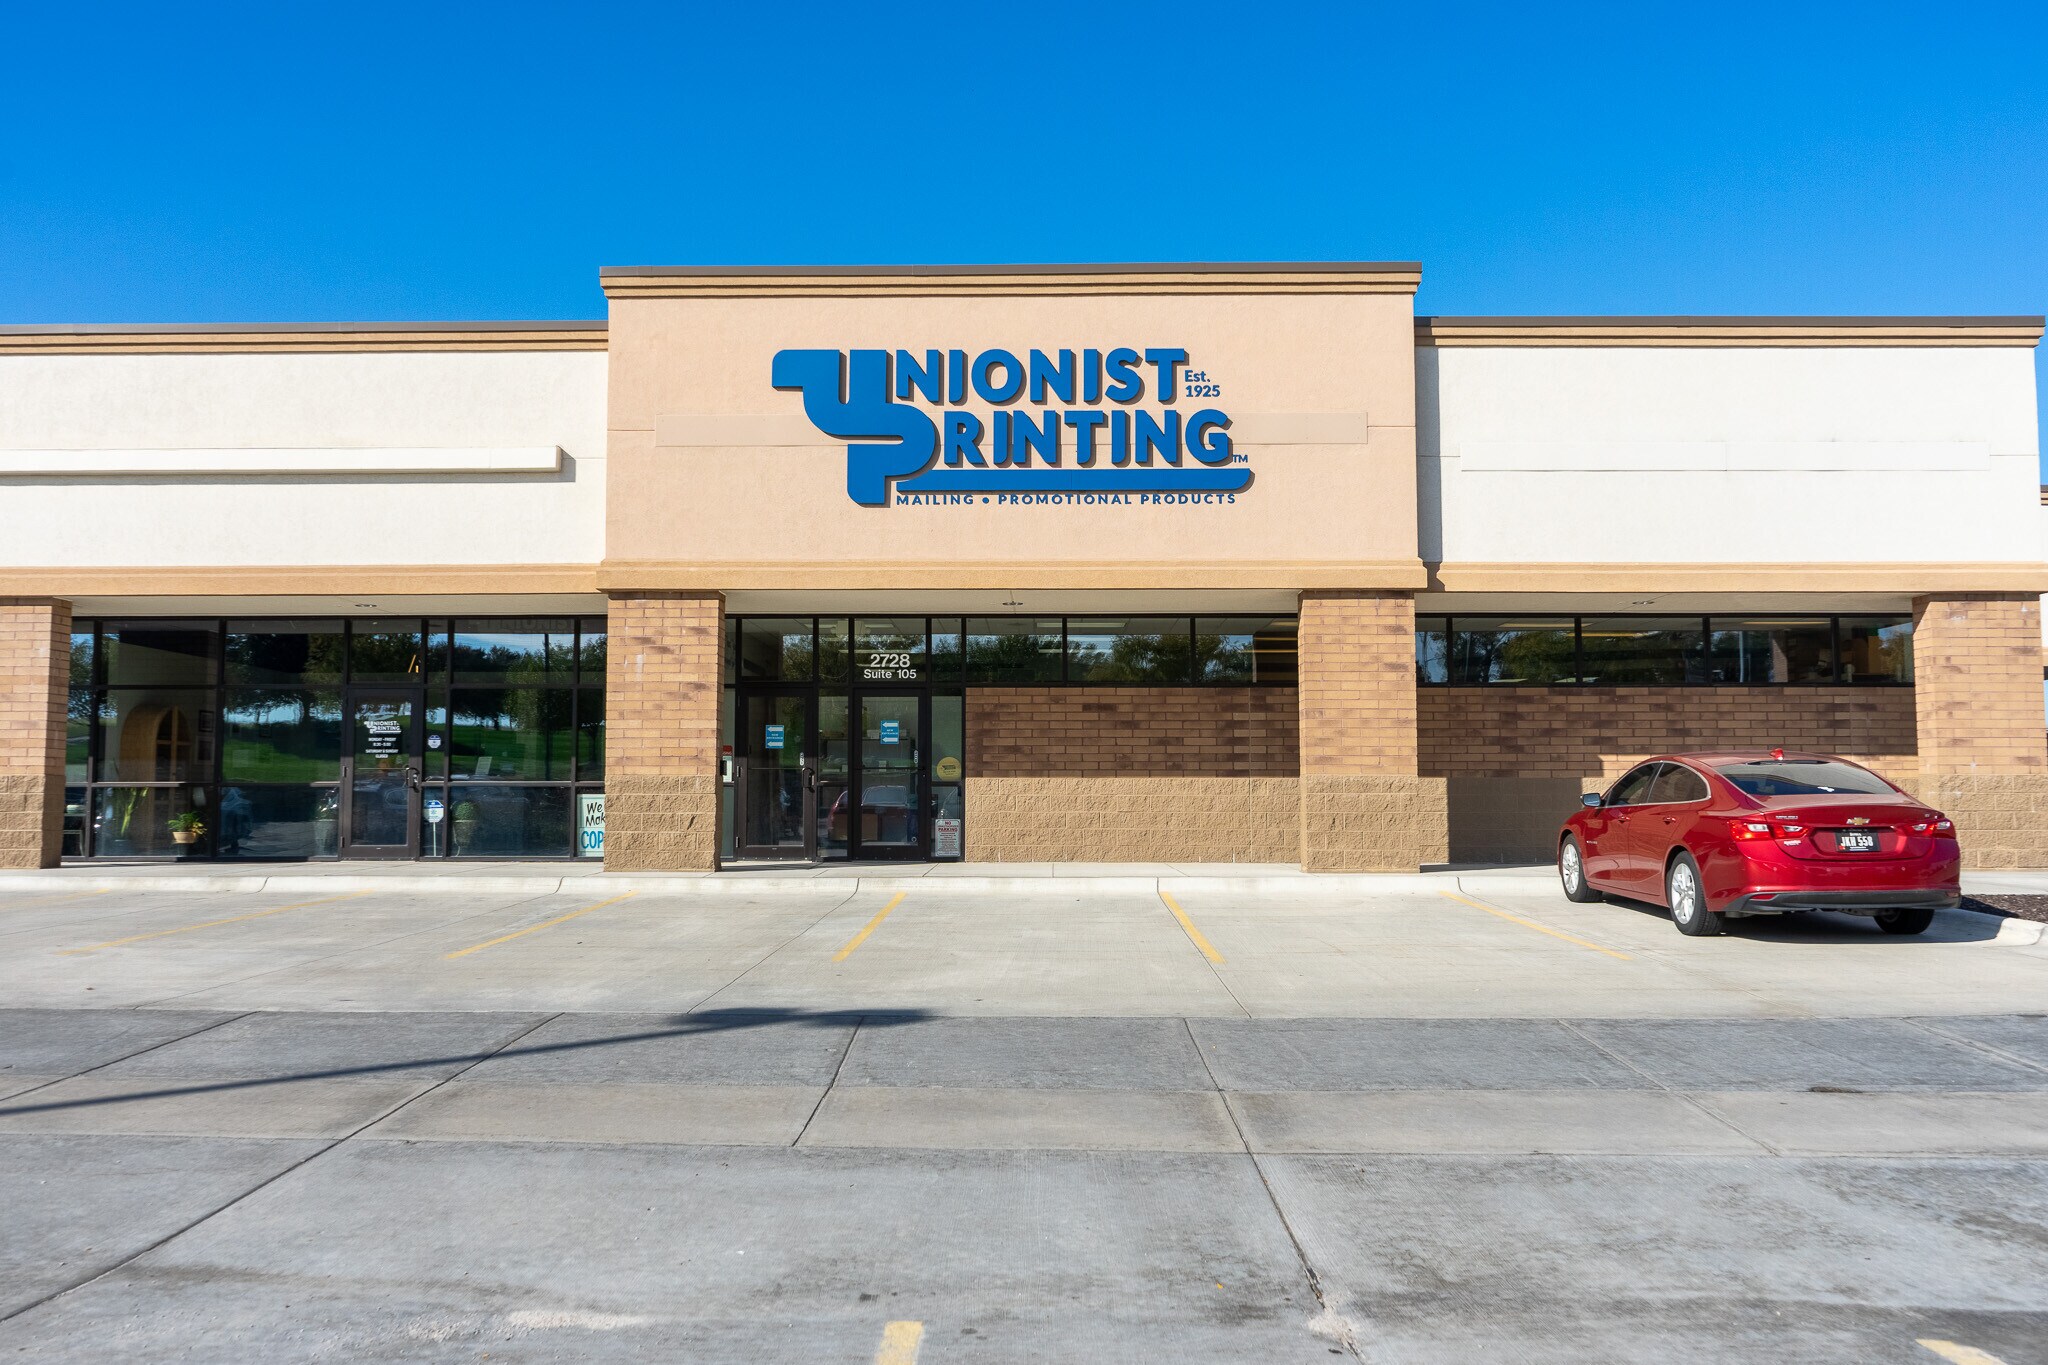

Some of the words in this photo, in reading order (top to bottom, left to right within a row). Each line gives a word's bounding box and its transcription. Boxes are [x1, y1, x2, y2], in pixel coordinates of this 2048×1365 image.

[1184, 370, 1211, 382] Est.
[772, 348, 1185, 420] UNIONIST
[1185, 385, 1220, 397] 1925
[847, 405, 1229, 500] PRINTING
[896, 494, 974, 505] MAILING
[998, 493, 1132, 505] PROMOTIONAL
[1141, 493, 1236, 505] PRODUCTS
[870, 654, 910, 667] 2728
[864, 669, 892, 678] Suite
[897, 669, 917, 678] 105
[587, 802, 603, 815] We
